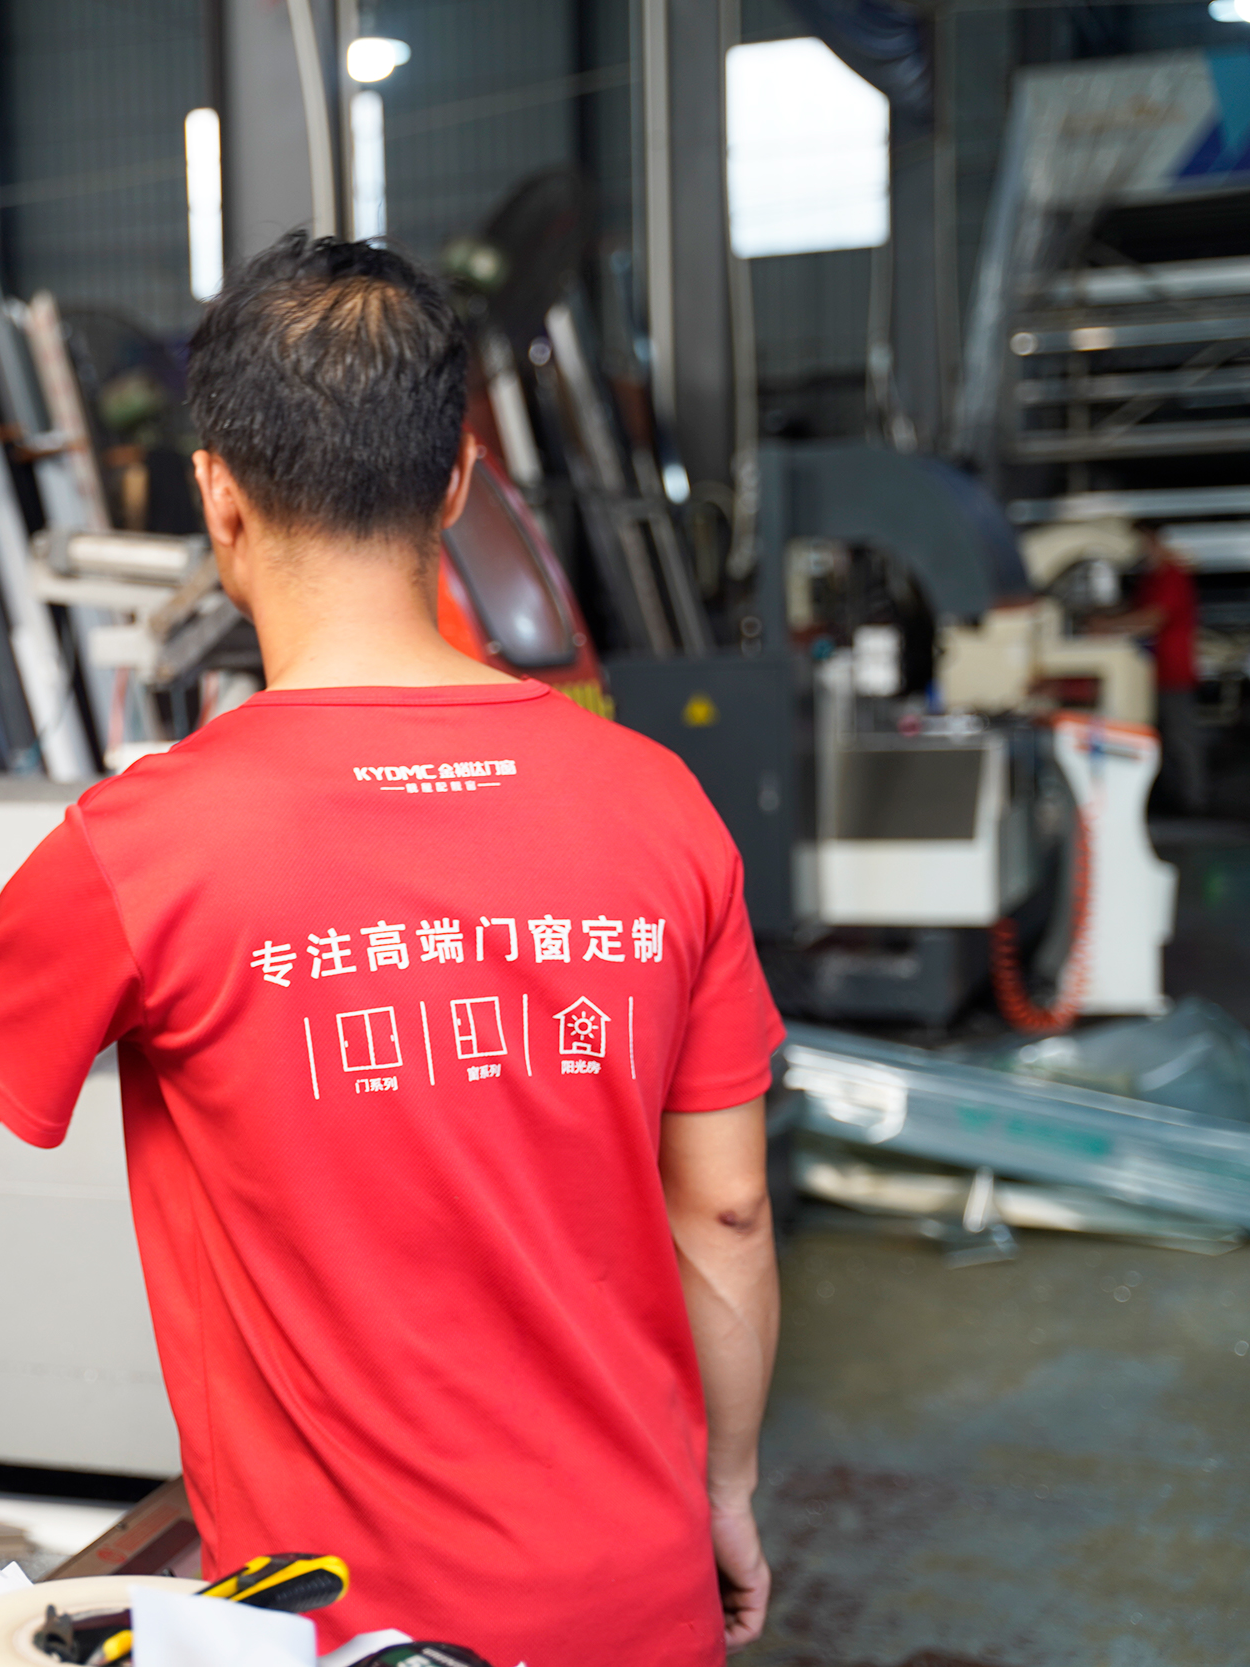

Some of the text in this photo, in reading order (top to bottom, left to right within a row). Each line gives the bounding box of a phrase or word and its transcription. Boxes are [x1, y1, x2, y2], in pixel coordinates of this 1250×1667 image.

[353, 764, 437, 781] KYDMC
[250, 914, 667, 988] 专注高端门窗定制
[467, 1063, 502, 1082] 窗系列
[561, 1059, 602, 1075] 阳光房
[355, 1076, 399, 1094] 门系列
